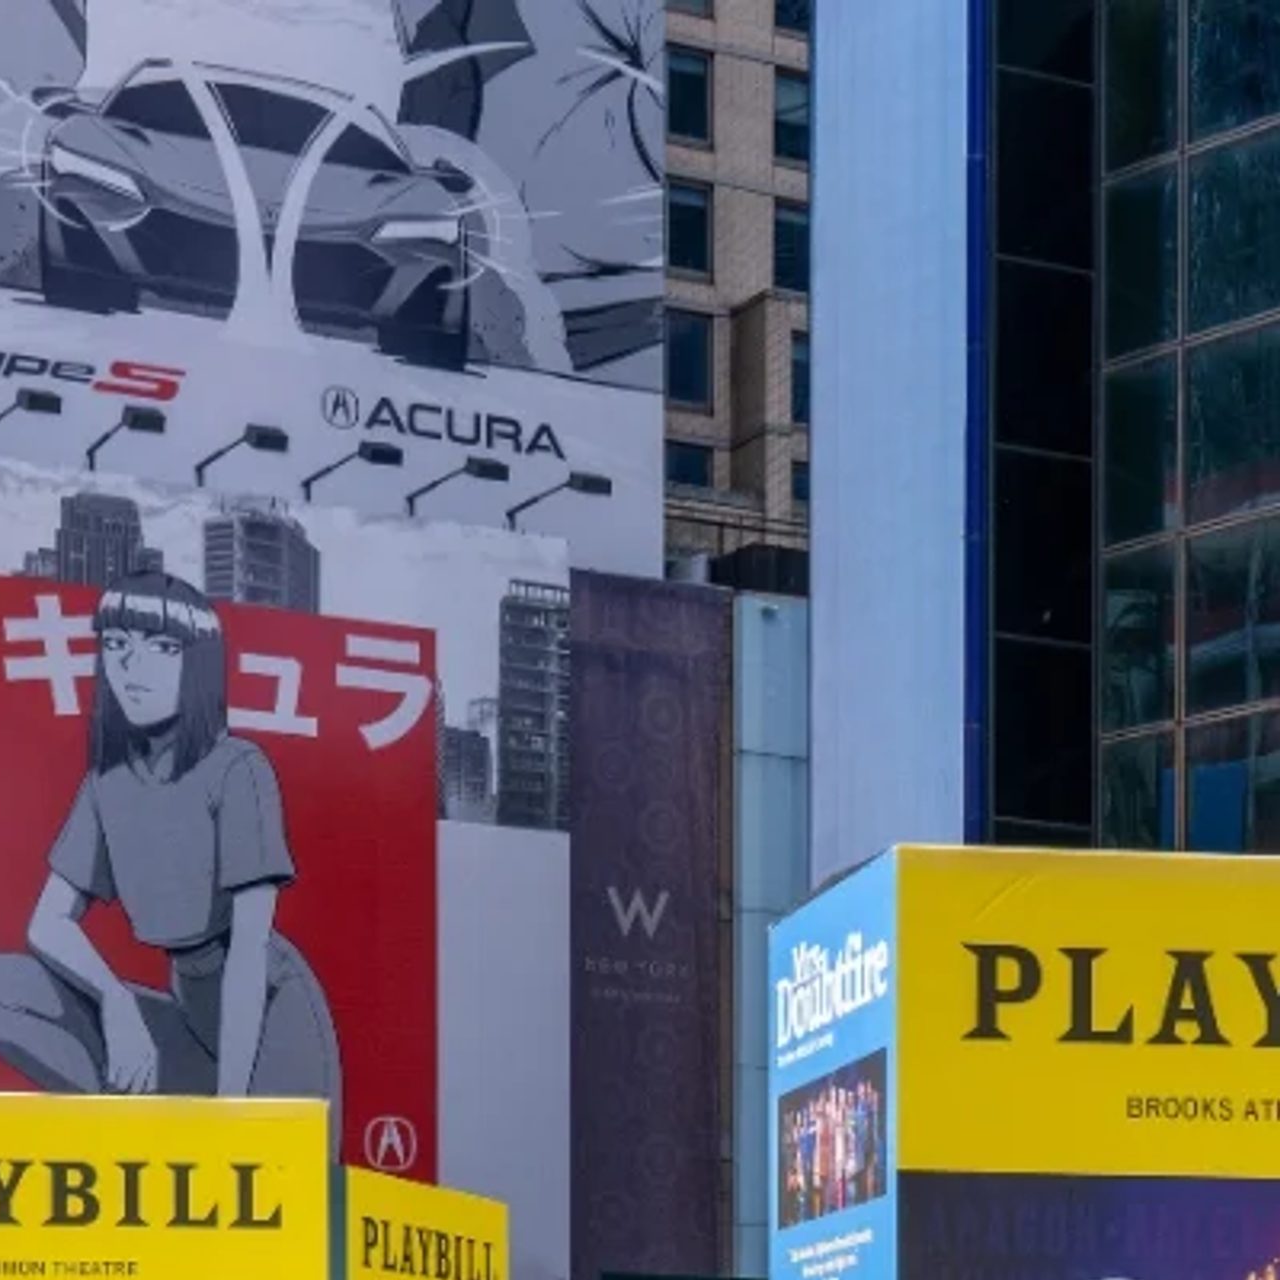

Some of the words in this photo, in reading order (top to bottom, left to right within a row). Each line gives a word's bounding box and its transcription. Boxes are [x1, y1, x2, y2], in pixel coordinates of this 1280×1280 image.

[91, 359, 186, 403] S
[364, 394, 567, 461] ACURA
[606, 886, 670, 938] W
[775, 931, 889, 1048] Doubtfire
[1125, 1094, 1235, 1124] BROOKS
[51, 1259, 139, 1278] THEATRE
